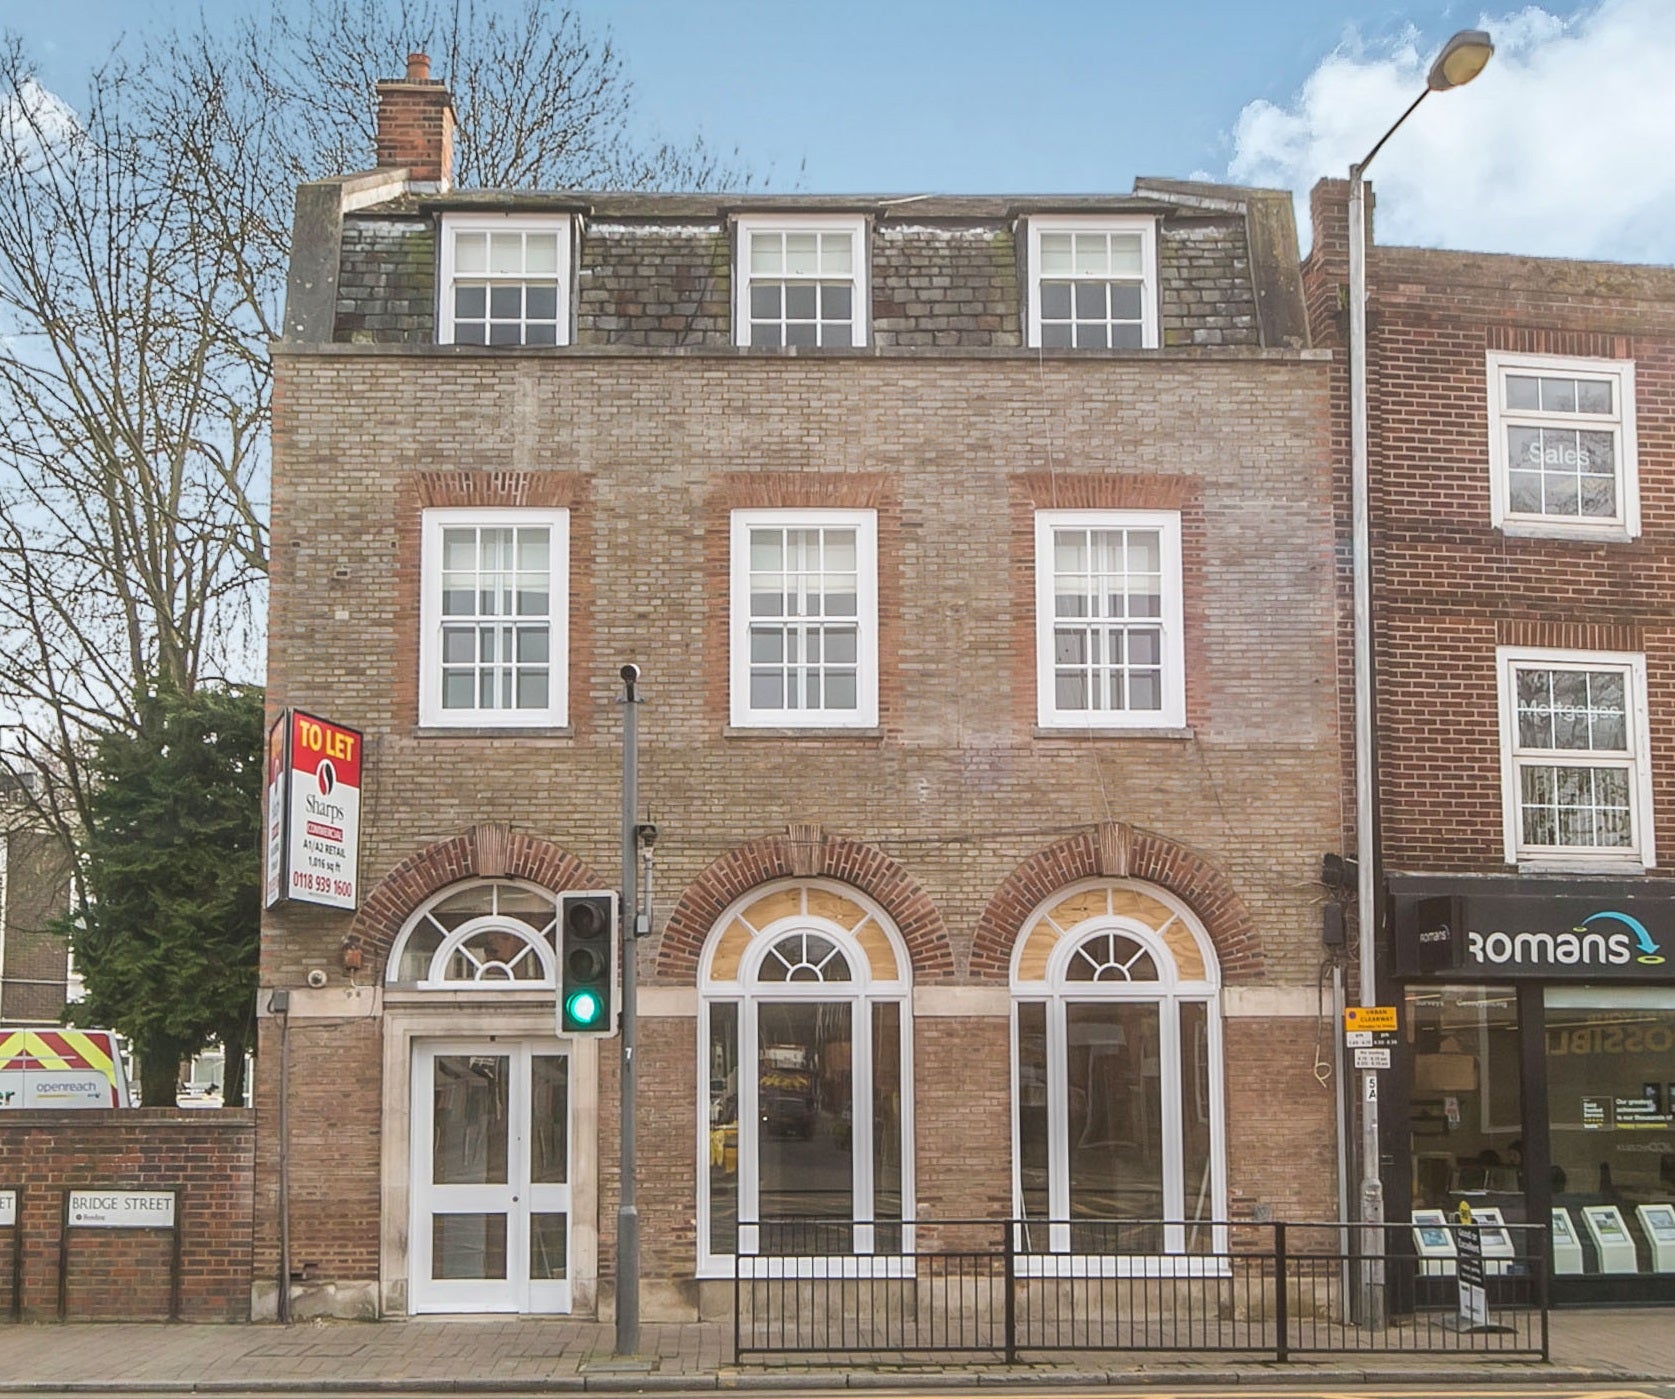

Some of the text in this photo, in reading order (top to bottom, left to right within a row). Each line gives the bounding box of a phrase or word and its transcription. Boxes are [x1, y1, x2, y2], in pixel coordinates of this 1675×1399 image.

[1529, 441, 1590, 466] Sales
[299, 719, 323, 752] TO
[325, 729, 355, 762] LET
[305, 793, 345, 825] Sharps
[303, 839, 347, 858] A1/A2 RETAIL
[326, 861, 335, 873] sq
[335, 861, 342, 872] ft
[293, 870, 314, 890] 0118
[315, 875, 332, 894] 939
[333, 879, 353, 898] 1600
[625, 1047, 633, 1059] 7
[36, 1081, 97, 1092] openreach
[1369, 1078, 1376, 1089] 5
[1368, 1089, 1376, 1100] A
[72, 1196, 173, 1211] BRIDGE STREET
